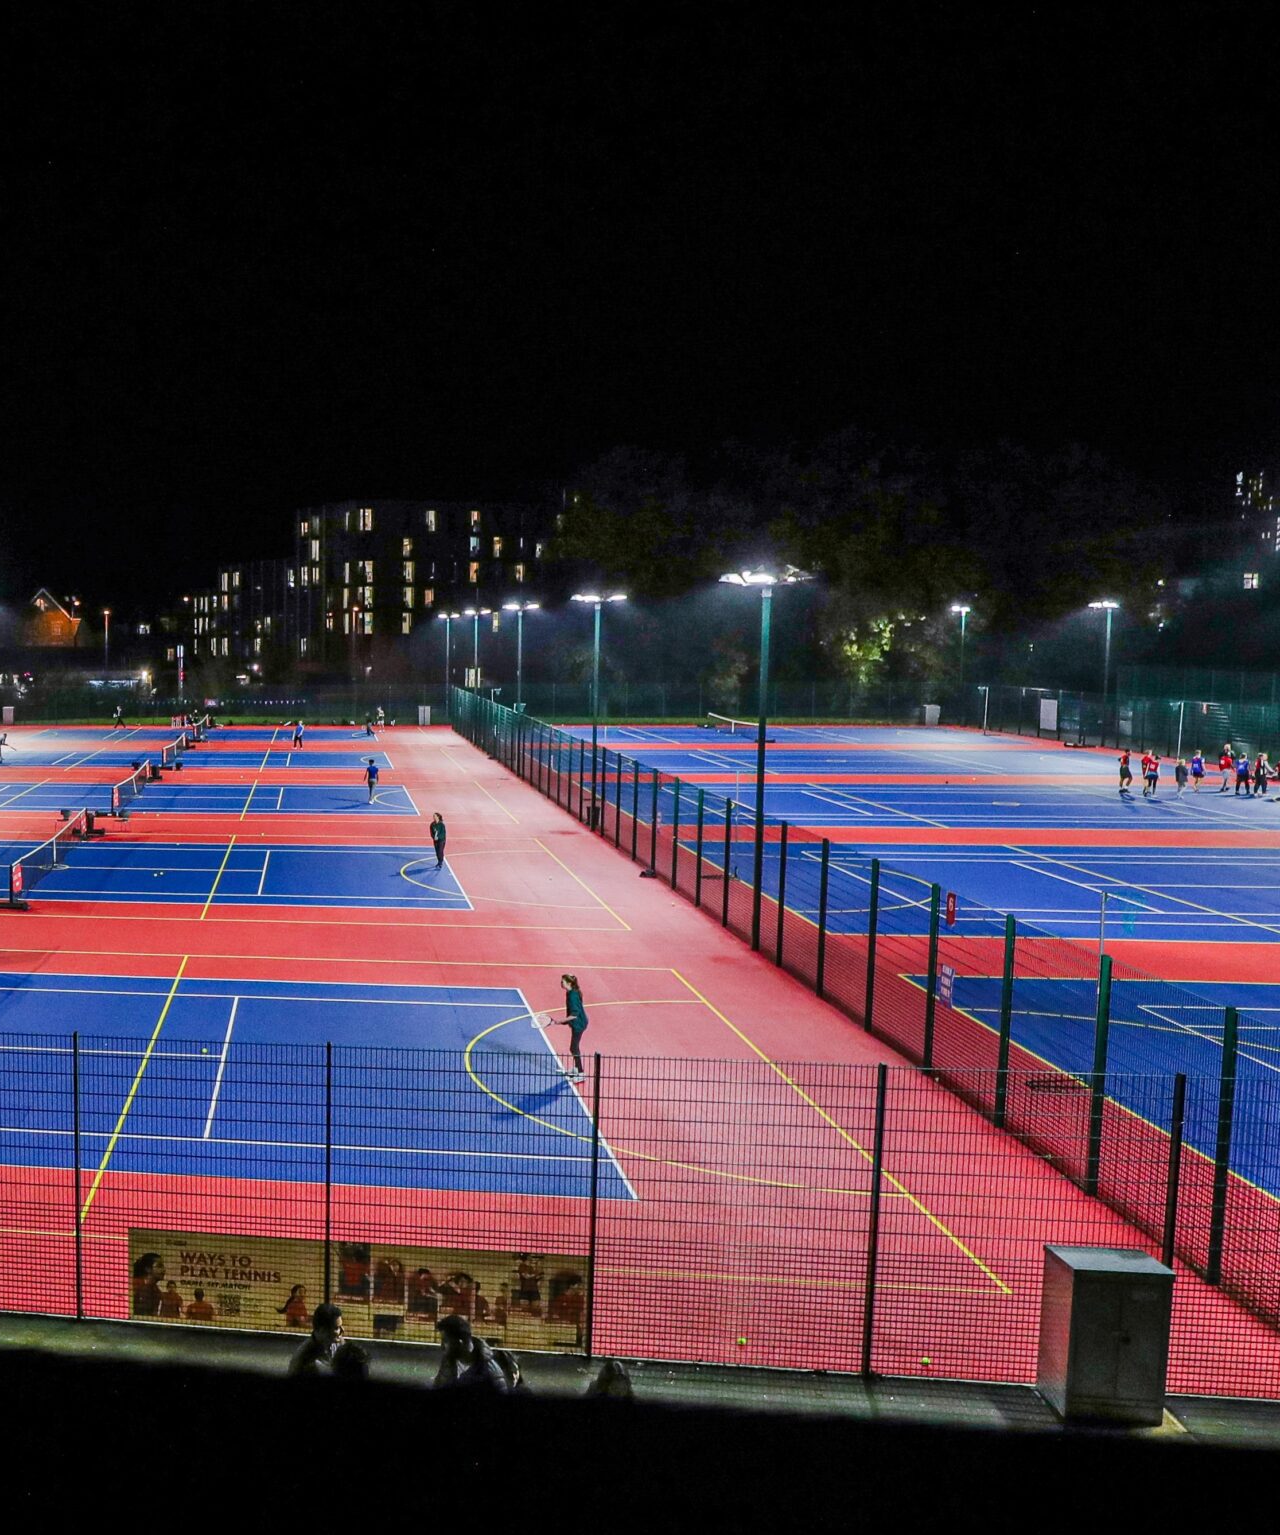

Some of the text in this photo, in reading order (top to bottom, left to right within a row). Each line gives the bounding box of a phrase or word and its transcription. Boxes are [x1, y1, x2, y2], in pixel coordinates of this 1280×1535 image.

[180, 1252, 252, 1268] WAYS TO
[180, 1265, 281, 1283] PLAY TENNIS
